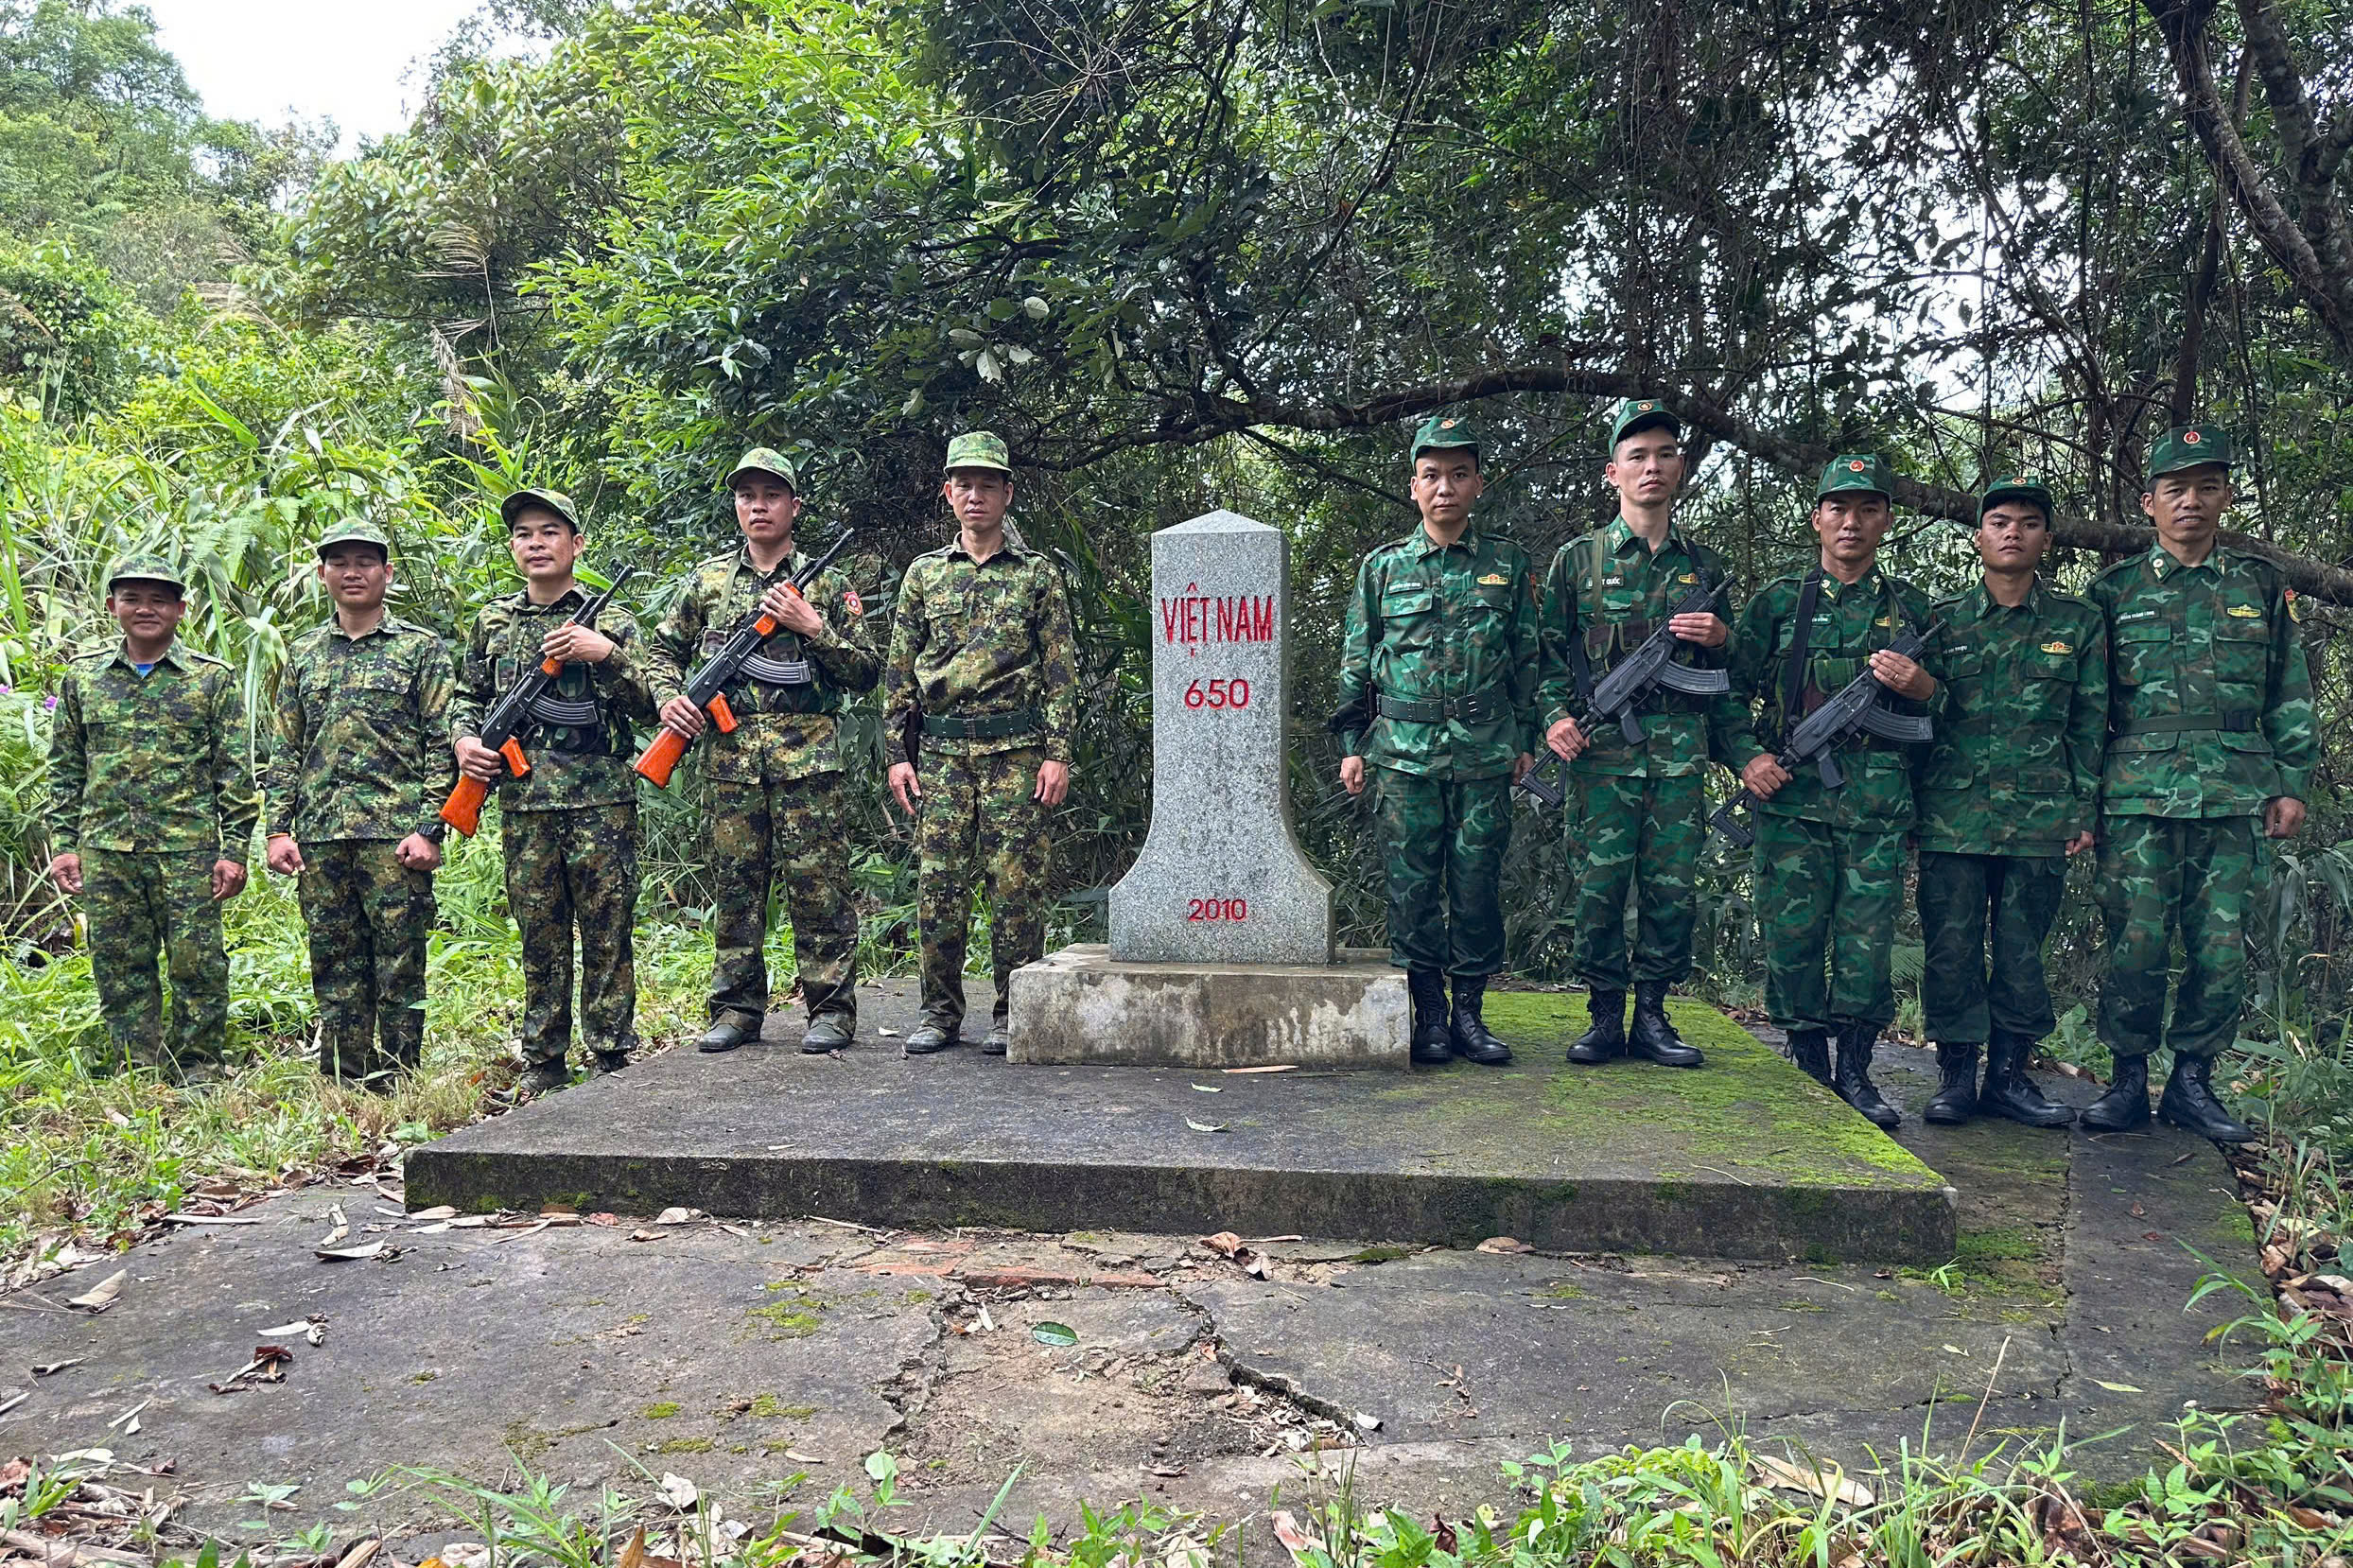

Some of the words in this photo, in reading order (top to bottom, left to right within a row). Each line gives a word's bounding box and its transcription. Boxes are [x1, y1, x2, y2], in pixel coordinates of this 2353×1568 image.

[1160, 582, 1211, 658] VIỆT
[1216, 595, 1272, 643] NAM
[1184, 679, 1249, 710] 650
[1188, 898, 1247, 922] 2010
